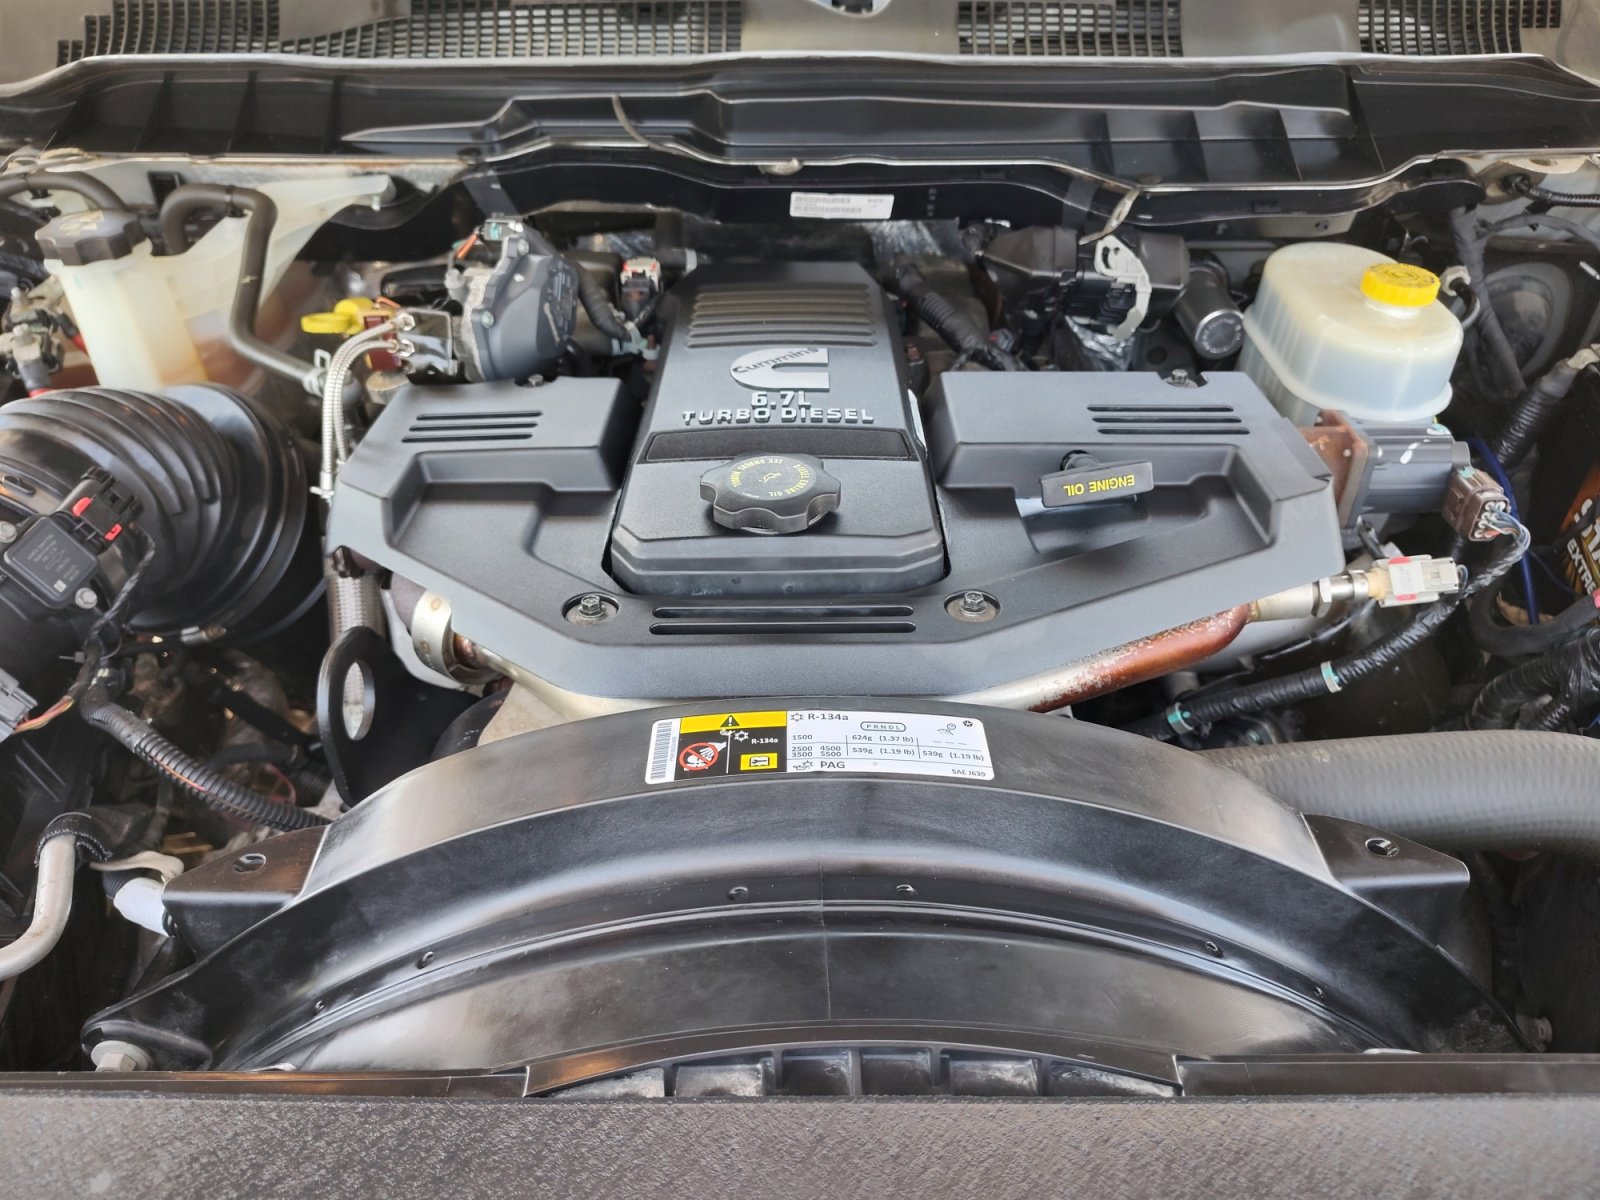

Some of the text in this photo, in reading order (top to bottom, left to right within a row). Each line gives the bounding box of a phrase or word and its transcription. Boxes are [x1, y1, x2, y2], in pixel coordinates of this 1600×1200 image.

[732, 348, 820, 374] Cummins
[751, 391, 811, 409] 6.7L
[682, 407, 875, 425] TURBO DIESEL
[1063, 474, 1135, 496] ENGINE OIL
[808, 713, 849, 721] R-134a
[880, 747, 901, 755] (1.19
[922, 750, 943, 758] 539g
[949, 752, 971, 760] (1.19
